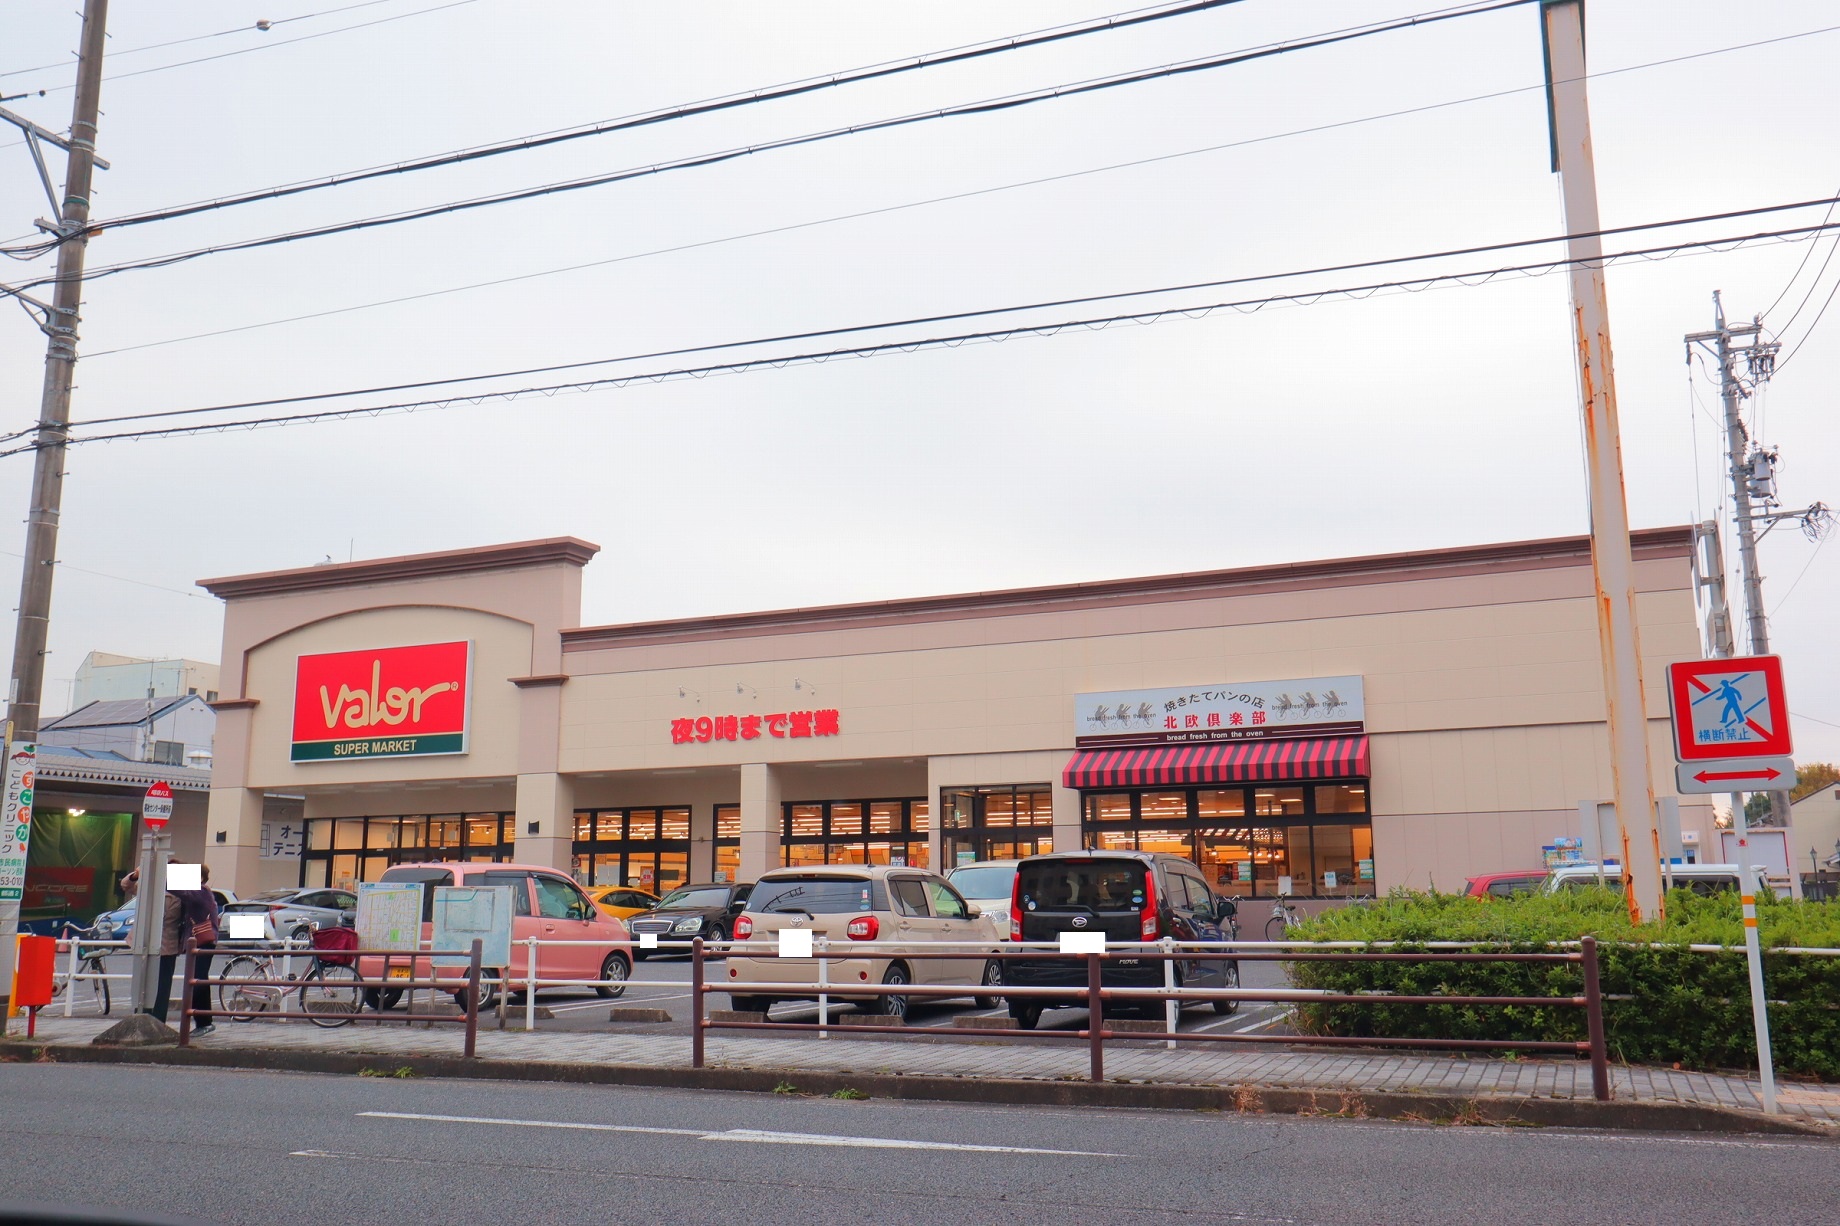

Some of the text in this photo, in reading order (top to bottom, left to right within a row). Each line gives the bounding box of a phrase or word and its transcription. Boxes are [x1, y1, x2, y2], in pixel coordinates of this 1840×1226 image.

[1164, 691, 1265, 712] 焼きたてパンの店
[671, 709, 840, 744] 夜9時まで営業
[1164, 710, 1266, 729] 北欧倶楽部
[1189, 732, 1207, 740] fresh
[1231, 730, 1242, 738] the
[1698, 727, 1751, 742] 横断禁止
[334, 739, 417, 756] SUPER MARKET
[1, 769, 21, 854] こどもクリニック
[17, 772, 34, 840] すこやか
